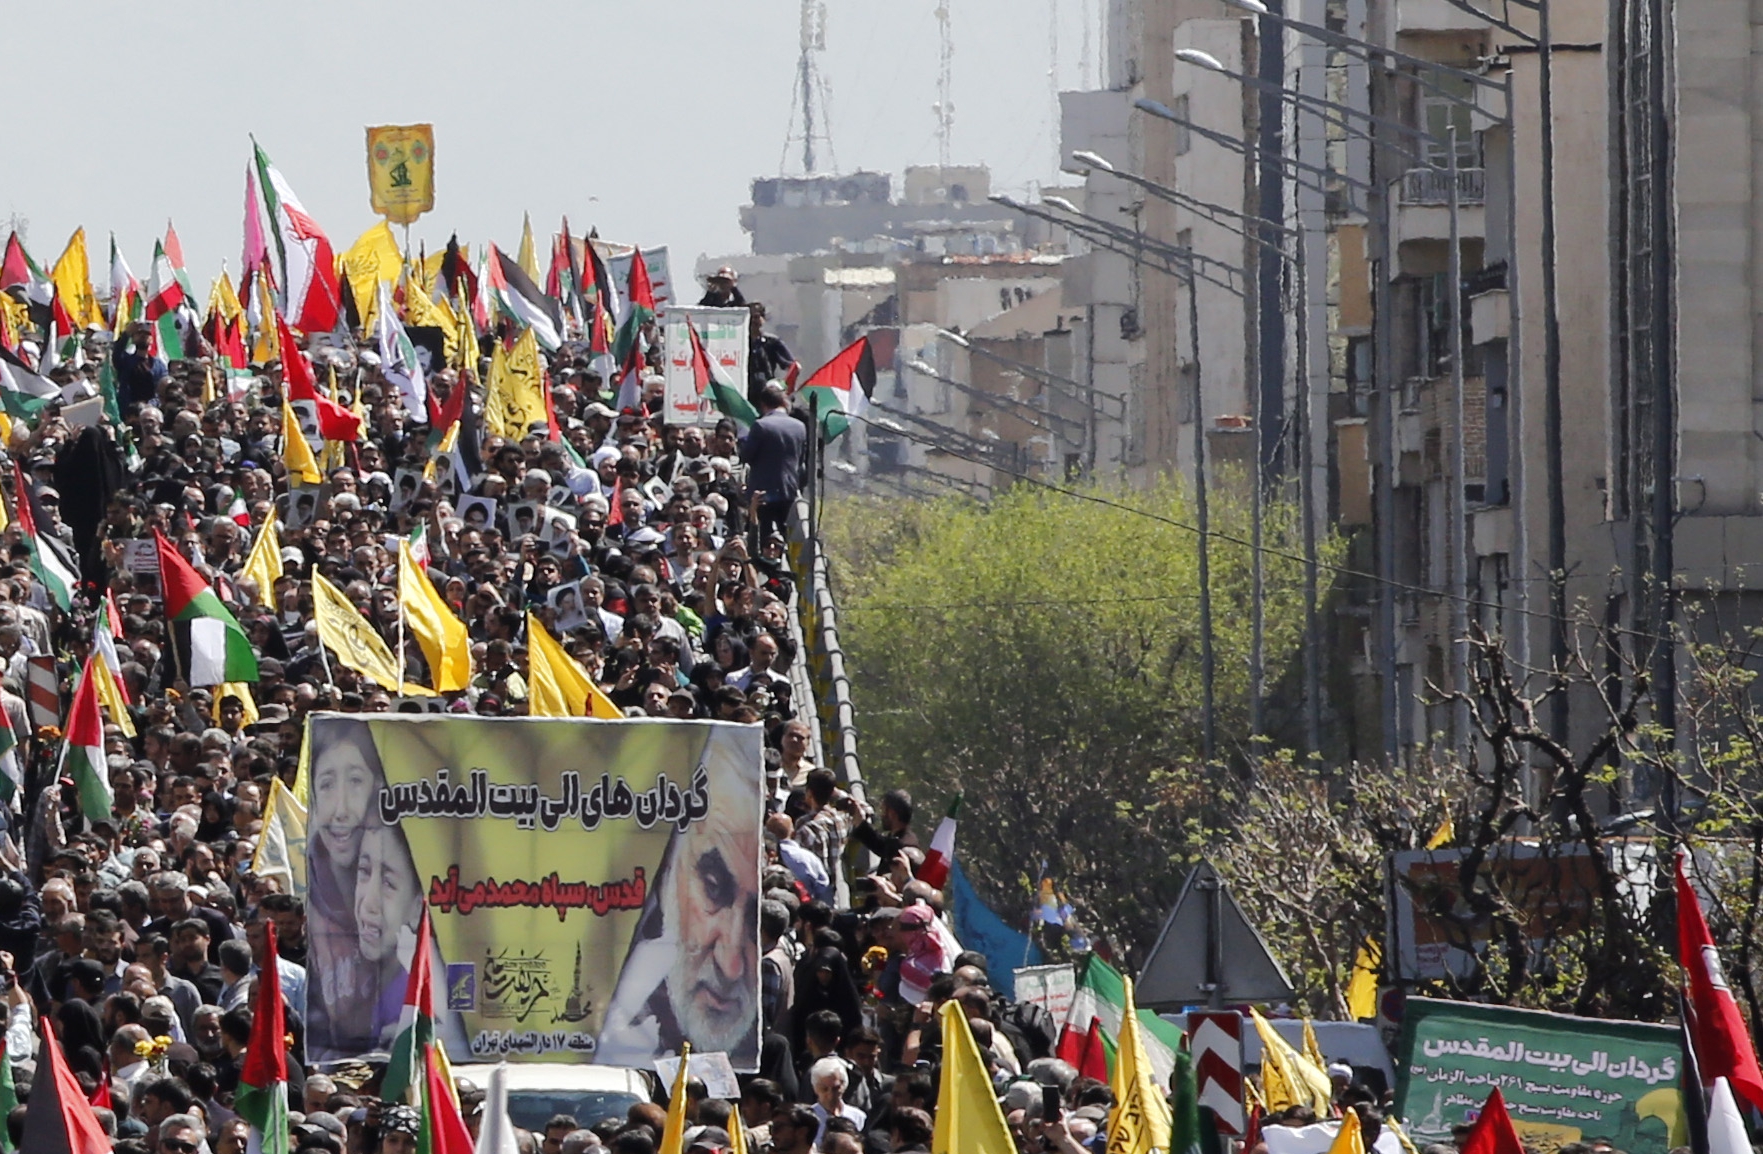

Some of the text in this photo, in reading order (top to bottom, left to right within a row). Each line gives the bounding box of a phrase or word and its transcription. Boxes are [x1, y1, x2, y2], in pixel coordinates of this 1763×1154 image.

[379, 765, 709, 833] گردان های الی بیت المقدس
[488, 877, 541, 908] محمد
[542, 871, 588, 922] سپاه
[473, 1033, 499, 1054] تهران
[552, 1033, 566, 1050] ۱۷
[567, 1033, 594, 1050] منطقه
[1422, 1037, 1677, 1085] گردان الی بیت المقدس
[1426, 1067, 1465, 1085] الزمان
[1524, 1081, 1551, 1095] بسیج
[1551, 1084, 1593, 1098] مقاومت
[1593, 1089, 1623, 1105] حوزه
